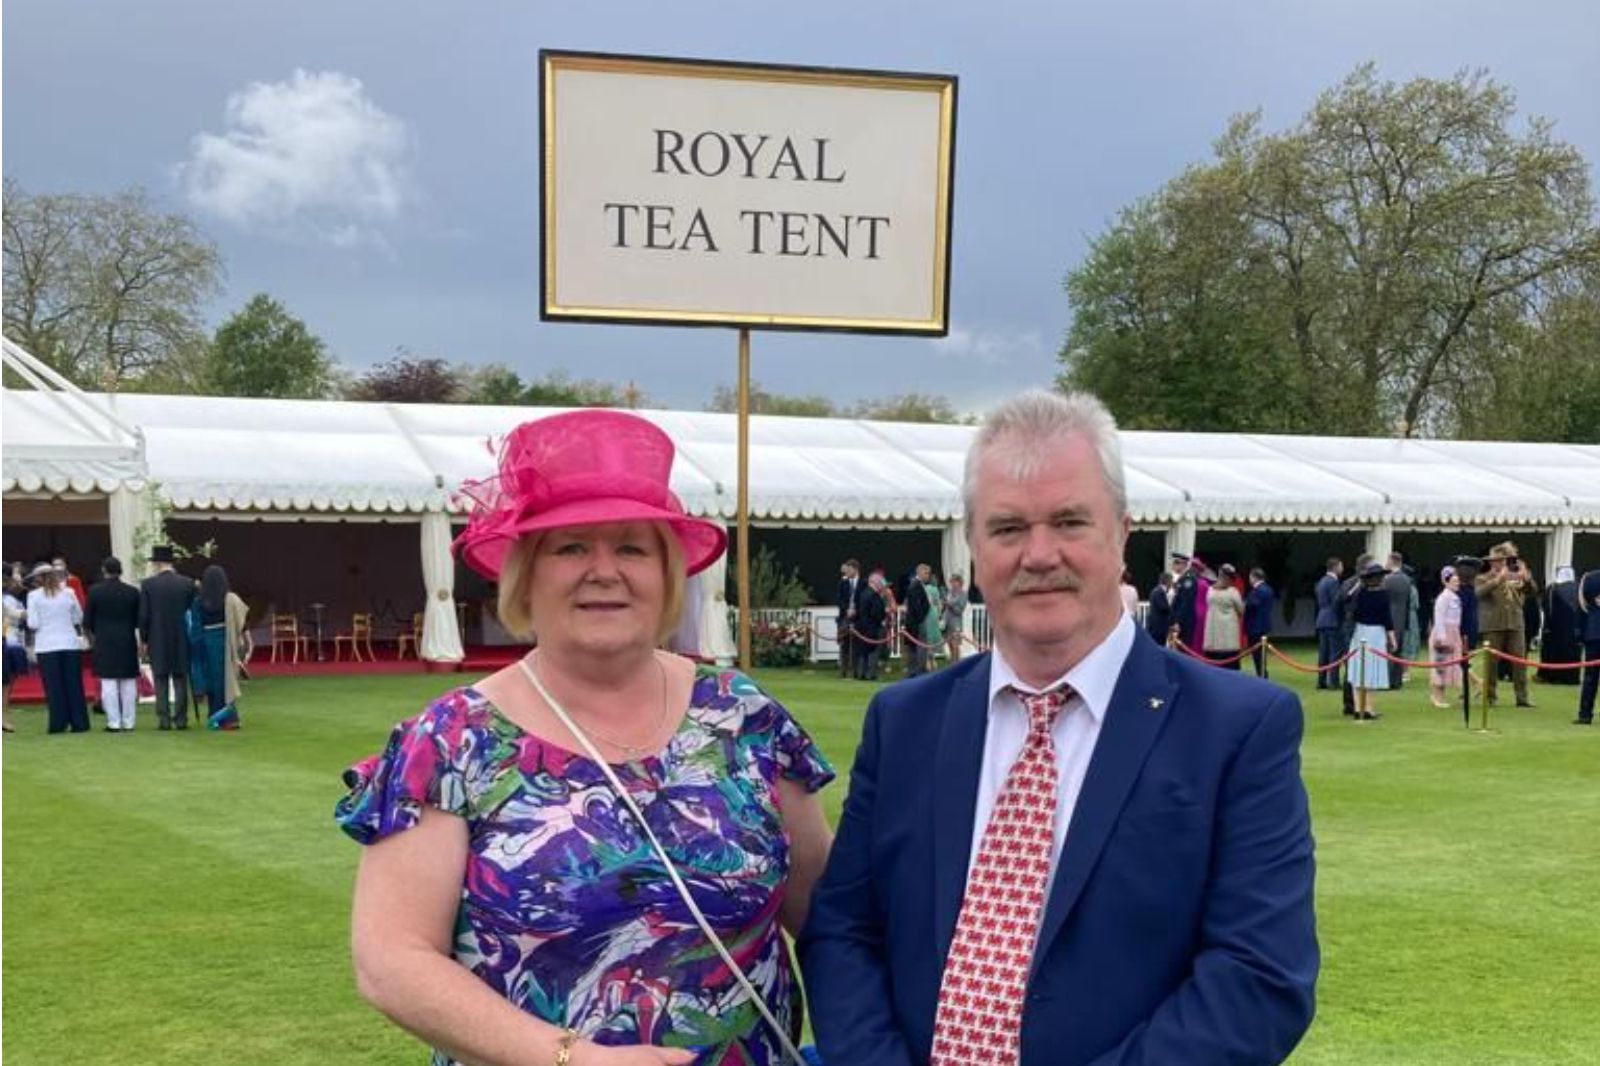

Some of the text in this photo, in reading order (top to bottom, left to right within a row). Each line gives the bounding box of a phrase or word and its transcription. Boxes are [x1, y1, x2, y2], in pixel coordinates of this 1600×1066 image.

[653, 129, 846, 183] ROYAL
[604, 203, 890, 259] TEA TENT
